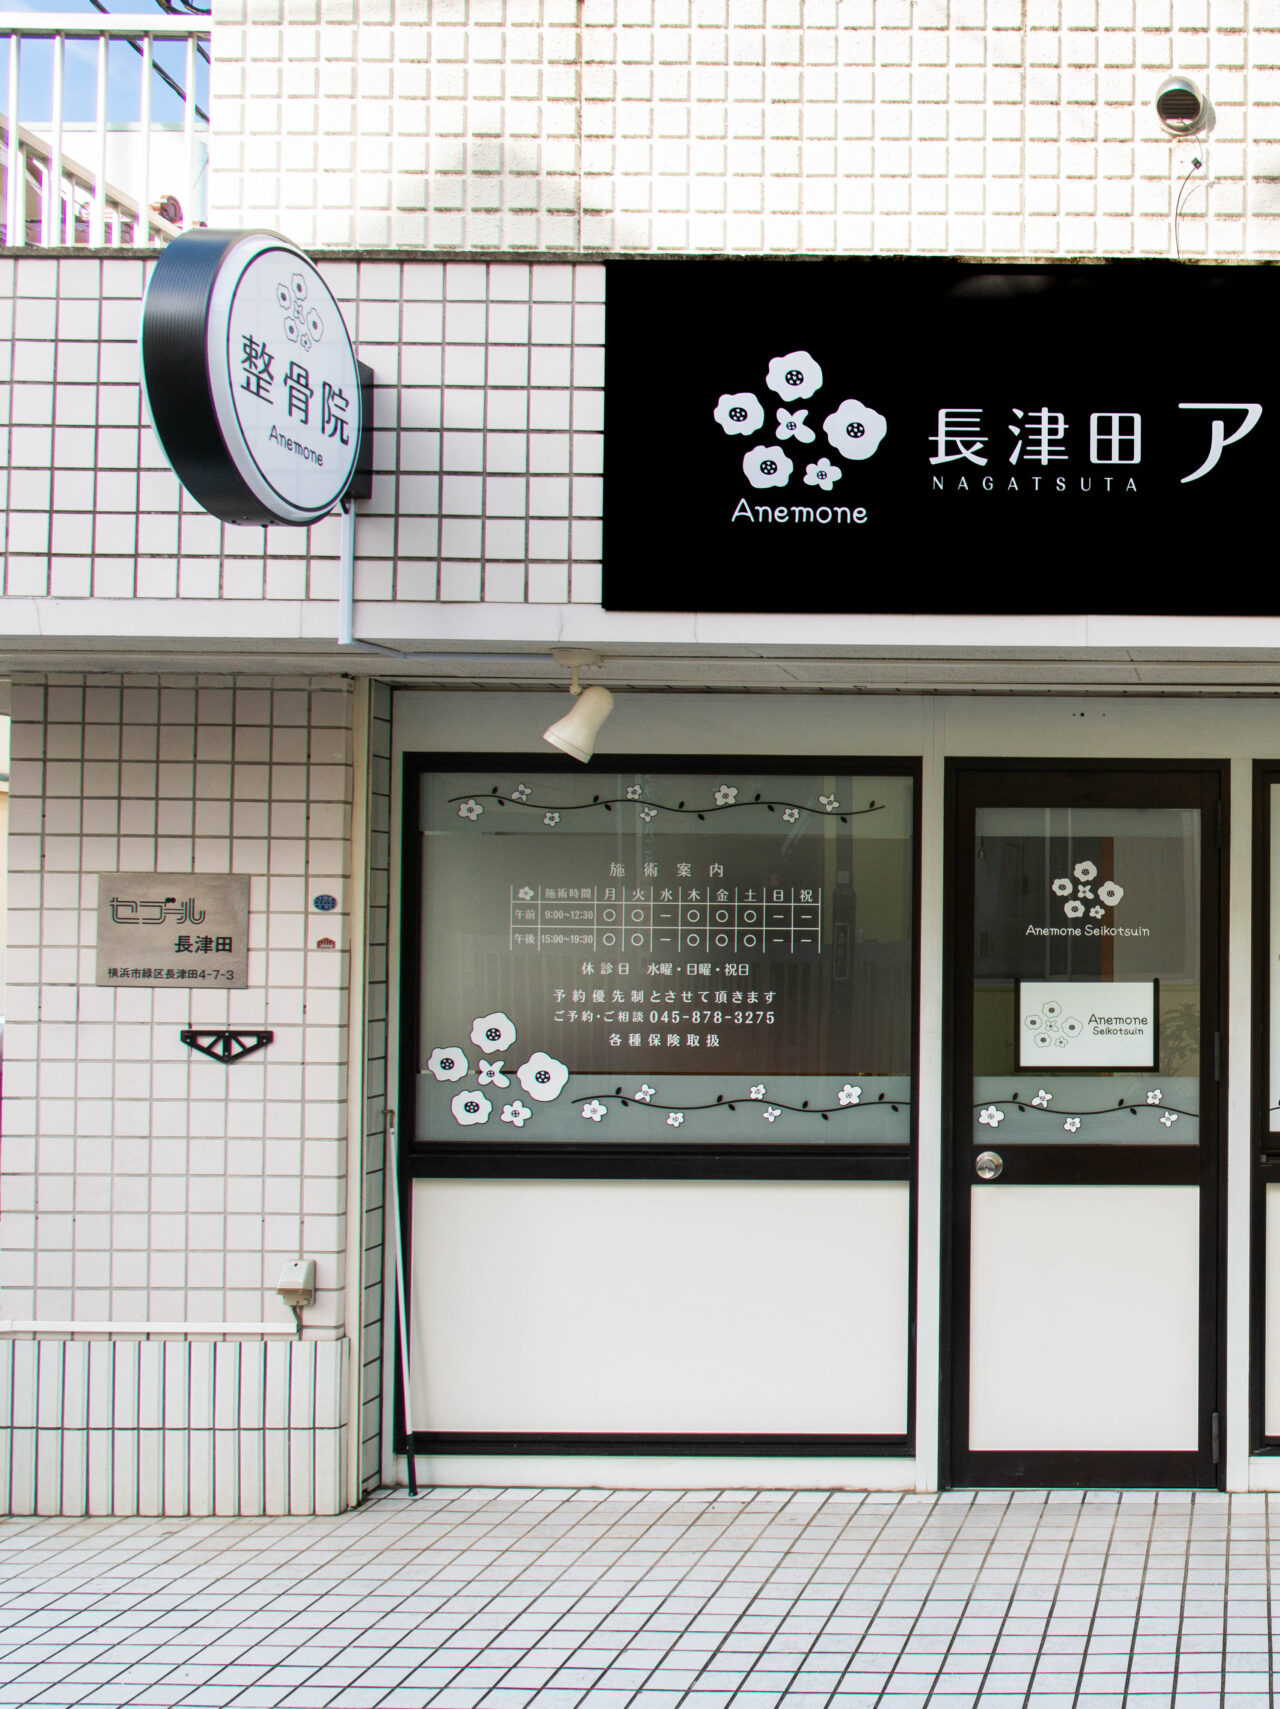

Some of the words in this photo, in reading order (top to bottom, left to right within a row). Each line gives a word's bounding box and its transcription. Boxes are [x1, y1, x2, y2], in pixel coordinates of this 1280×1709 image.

[240, 333, 350, 446] 整骨院
[928, 406, 1142, 467] 長津田
[270, 424, 324, 467] Anemone
[932, 475, 1138, 492] NAGATSUTA
[731, 497, 869, 524] Anemone
[609, 862, 725, 878] 施術案内
[544, 887, 592, 899] 施術時間
[604, 887, 616, 901] 月
[632, 887, 645, 901] 火
[659, 888, 673, 902] 水
[687, 888, 701, 902] 木
[716, 888, 729, 902] 金
[744, 889, 758, 902] 土
[773, 889, 784, 902] 日
[800, 889, 813, 903] 祝
[514, 909, 536, 920] 午前
[514, 933, 536, 944] 午後
[1025, 925, 1082, 936] Anemone
[1084, 925, 1150, 937] Seikotsuin
[174, 935, 233, 954] 長津田
[107, 967, 235, 981] 横浜市緑区長津田4-7-3
[581, 962, 630, 976] 休診日
[649, 1010, 776, 1025] 045-878-3275
[1087, 1013, 1148, 1026] Anemone
[1092, 1026, 1144, 1036] Seikotsuin
[608, 1033, 720, 1048] 各種保険取扱
